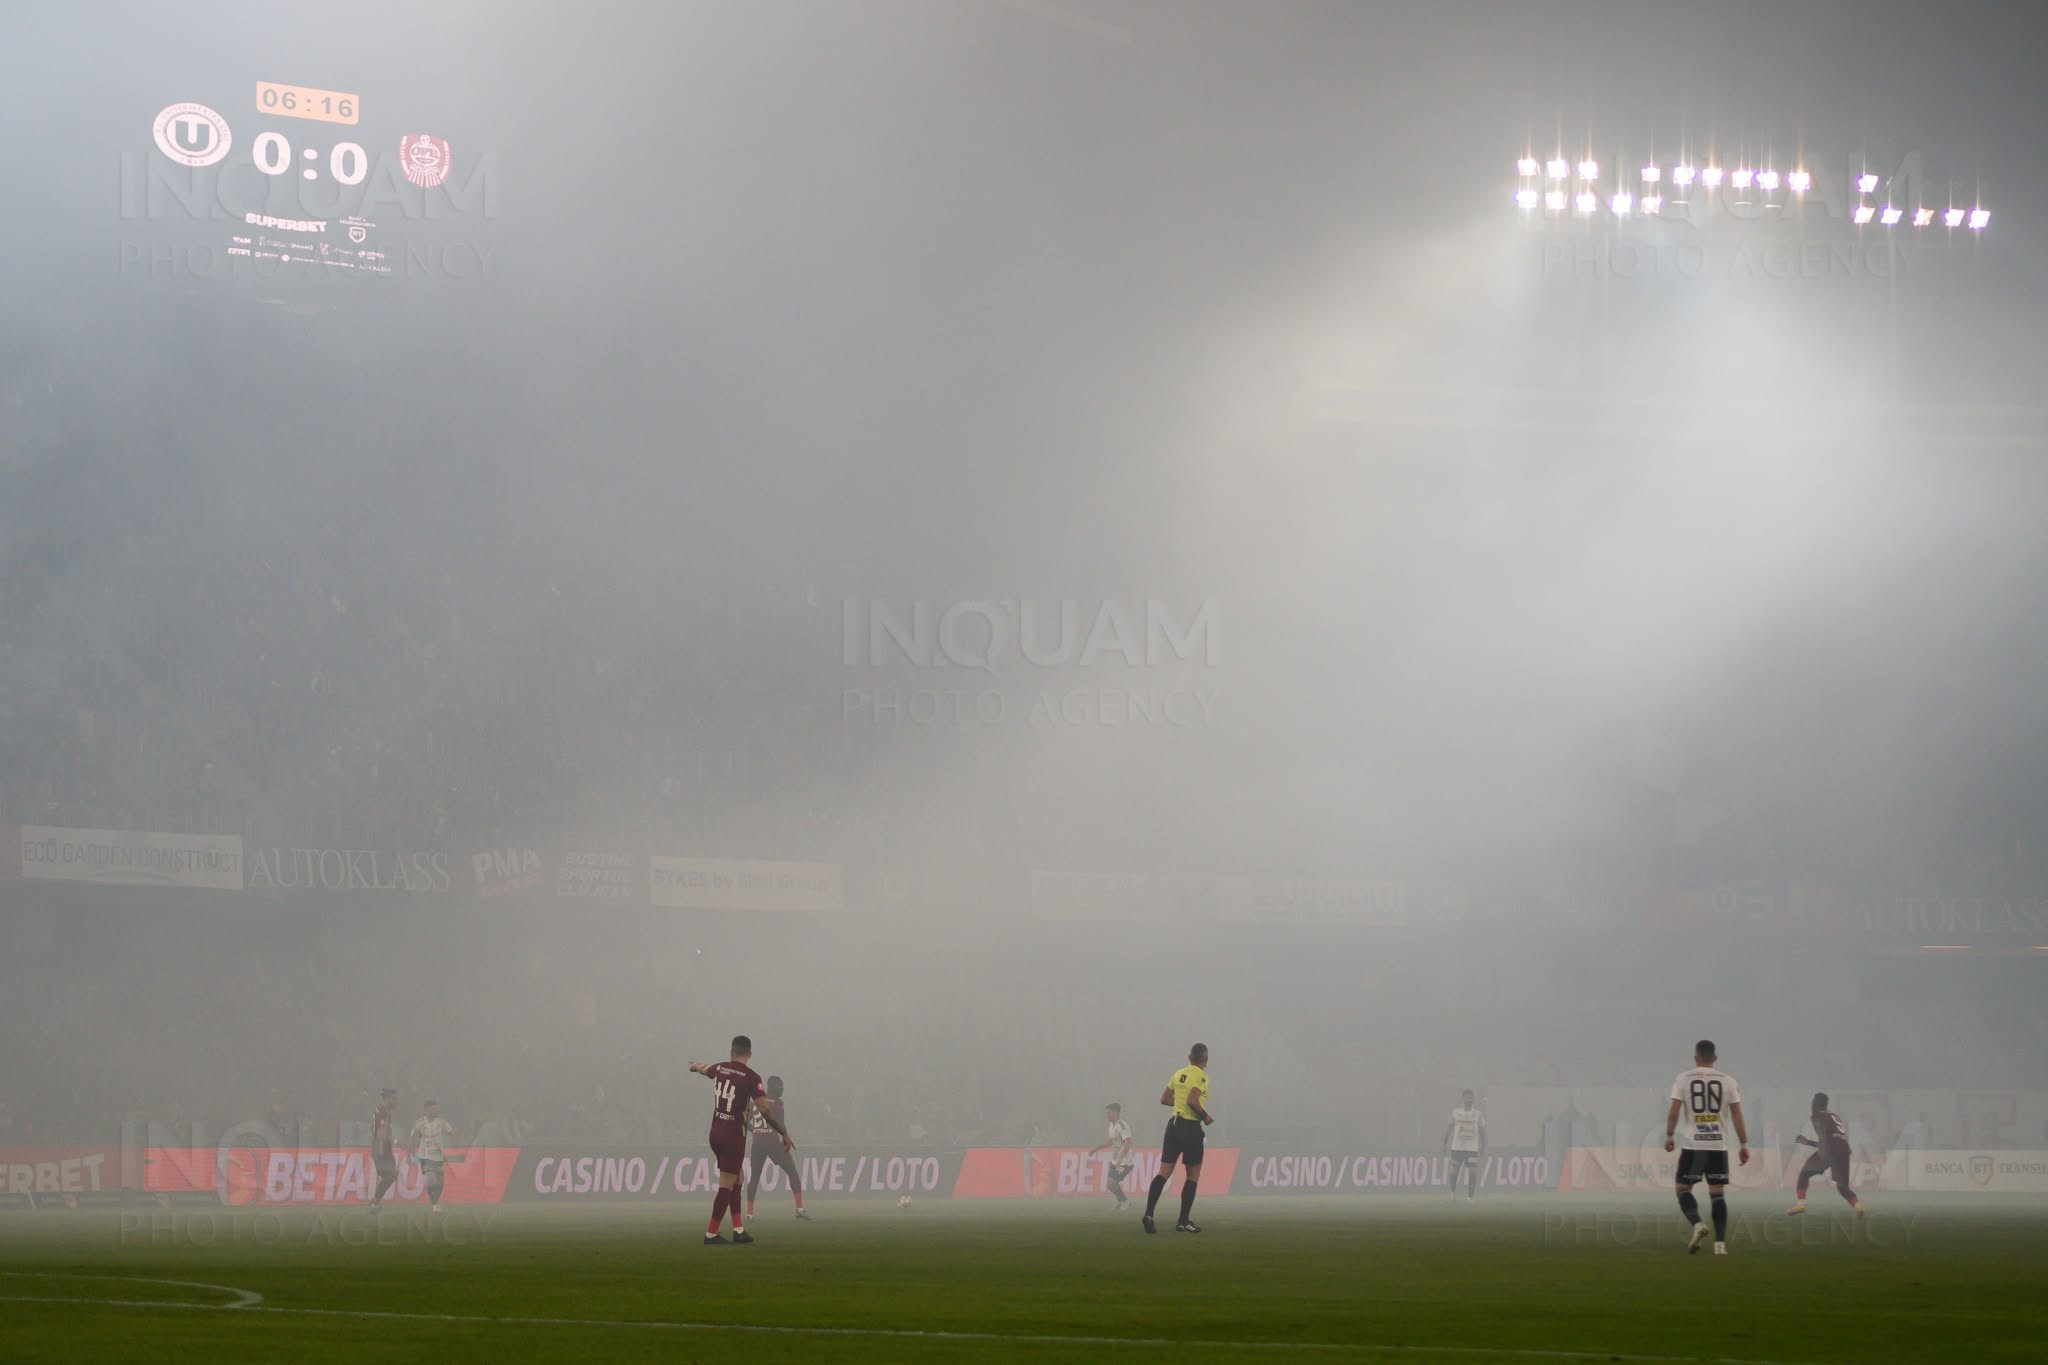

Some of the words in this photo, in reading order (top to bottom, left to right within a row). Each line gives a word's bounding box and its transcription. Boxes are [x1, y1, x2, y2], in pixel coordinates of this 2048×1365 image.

[245, 212, 327, 232] SUPERBET
[248, 848, 450, 890] AUTOKLASS
[1855, 895, 2048, 933] AUTOKLAS
[1690, 1080, 1723, 1113] 80
[535, 1157, 646, 1193] CASINO
[870, 1156, 940, 1191] LOTO
[1250, 1156, 1332, 1187] CASINO
[1352, 1156, 1428, 1186] CASINO
[1496, 1156, 1548, 1186] LOTO
[1924, 1162, 1964, 1174] BANCA
